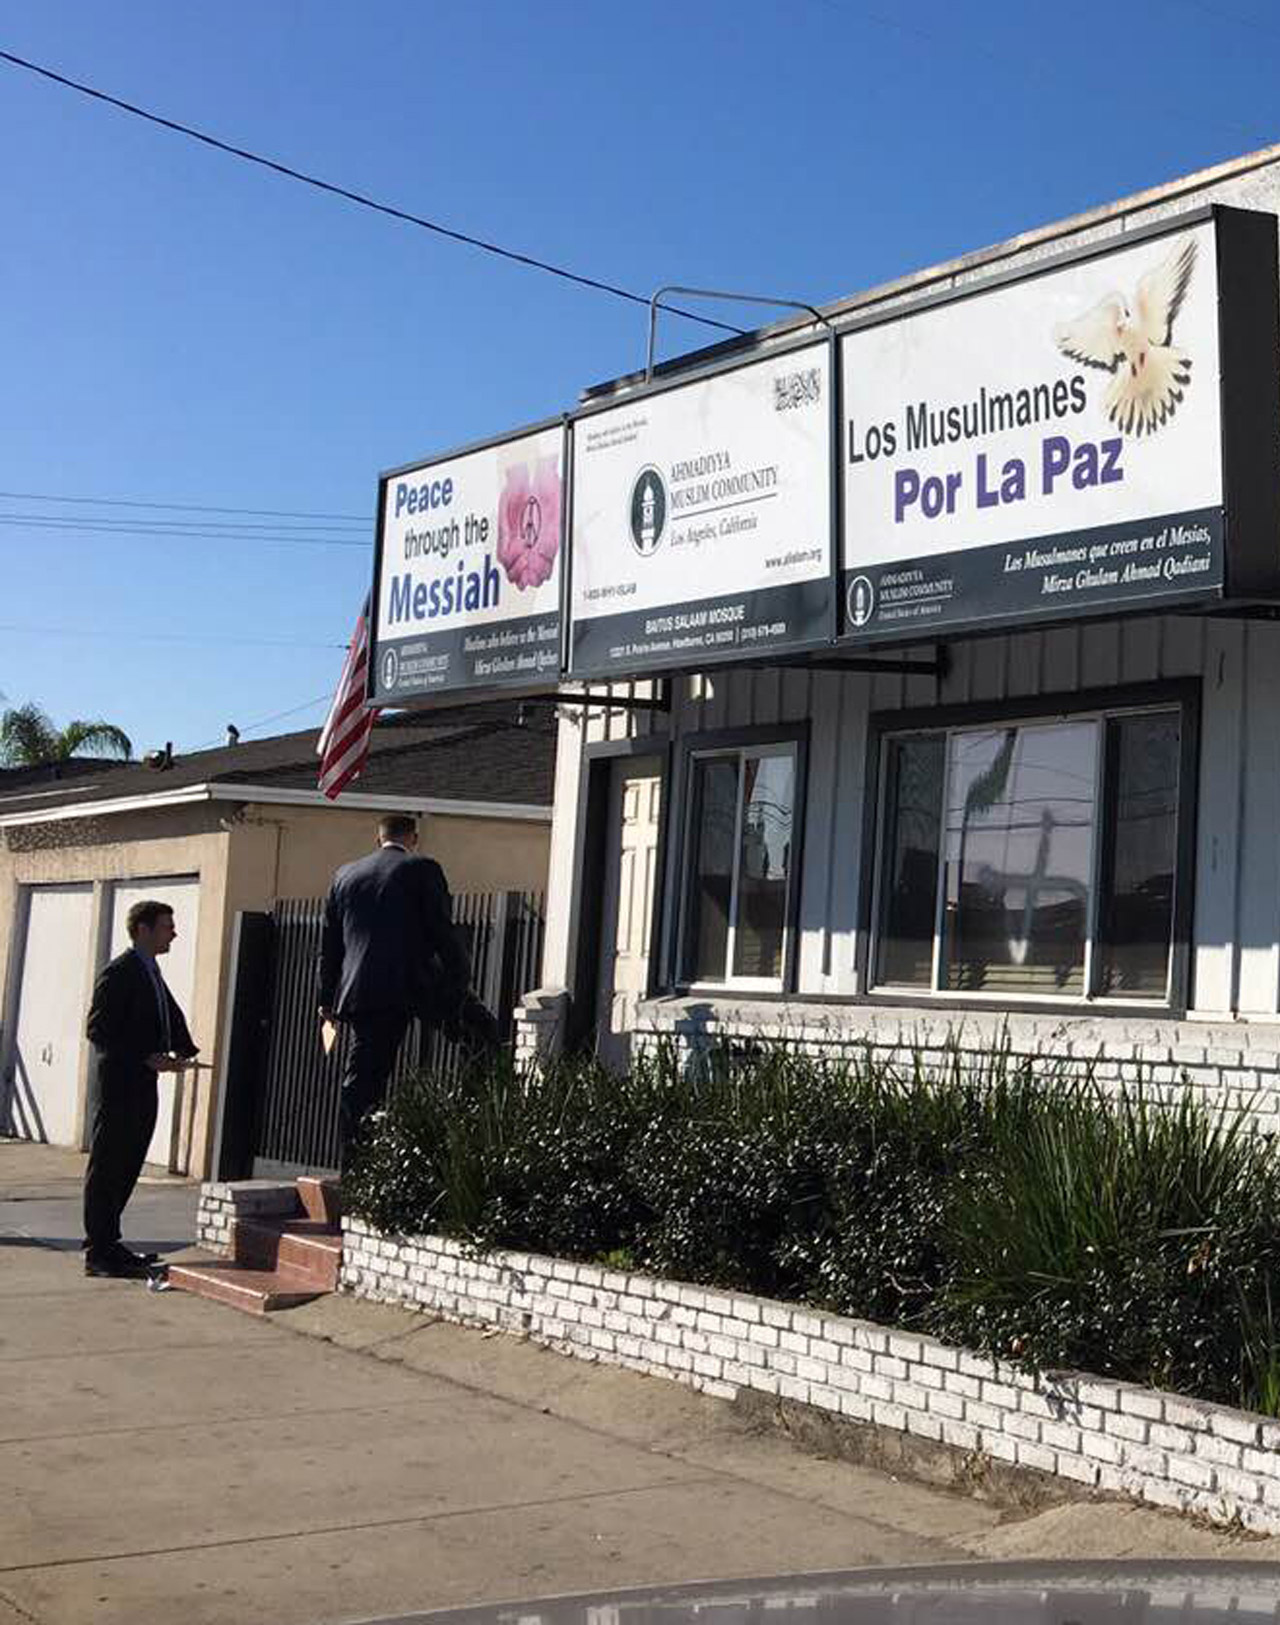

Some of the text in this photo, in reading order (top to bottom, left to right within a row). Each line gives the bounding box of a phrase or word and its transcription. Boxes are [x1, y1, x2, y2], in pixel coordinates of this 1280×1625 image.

[849, 375, 1087, 464] Los Musulmanes
[670, 466, 778, 509] MUSLIM COMMUNITY
[671, 450, 731, 482] AHMADIYYA
[895, 436, 1123, 523] Por La Paz
[395, 476, 453, 519] Peace
[405, 513, 489, 560] through the
[1003, 553, 1022, 573] Los
[1024, 547, 1088, 570] Musulmanes
[1089, 543, 1108, 564] que
[1110, 538, 1138, 556] creen
[1140, 536, 1154, 552] en
[1156, 528, 1168, 549] el
[388, 554, 500, 626] Messiah
[1040, 552, 1211, 595] Mirza Ghulam Ahmad Qadiani
[709, 604, 745, 625] MOSQUE
